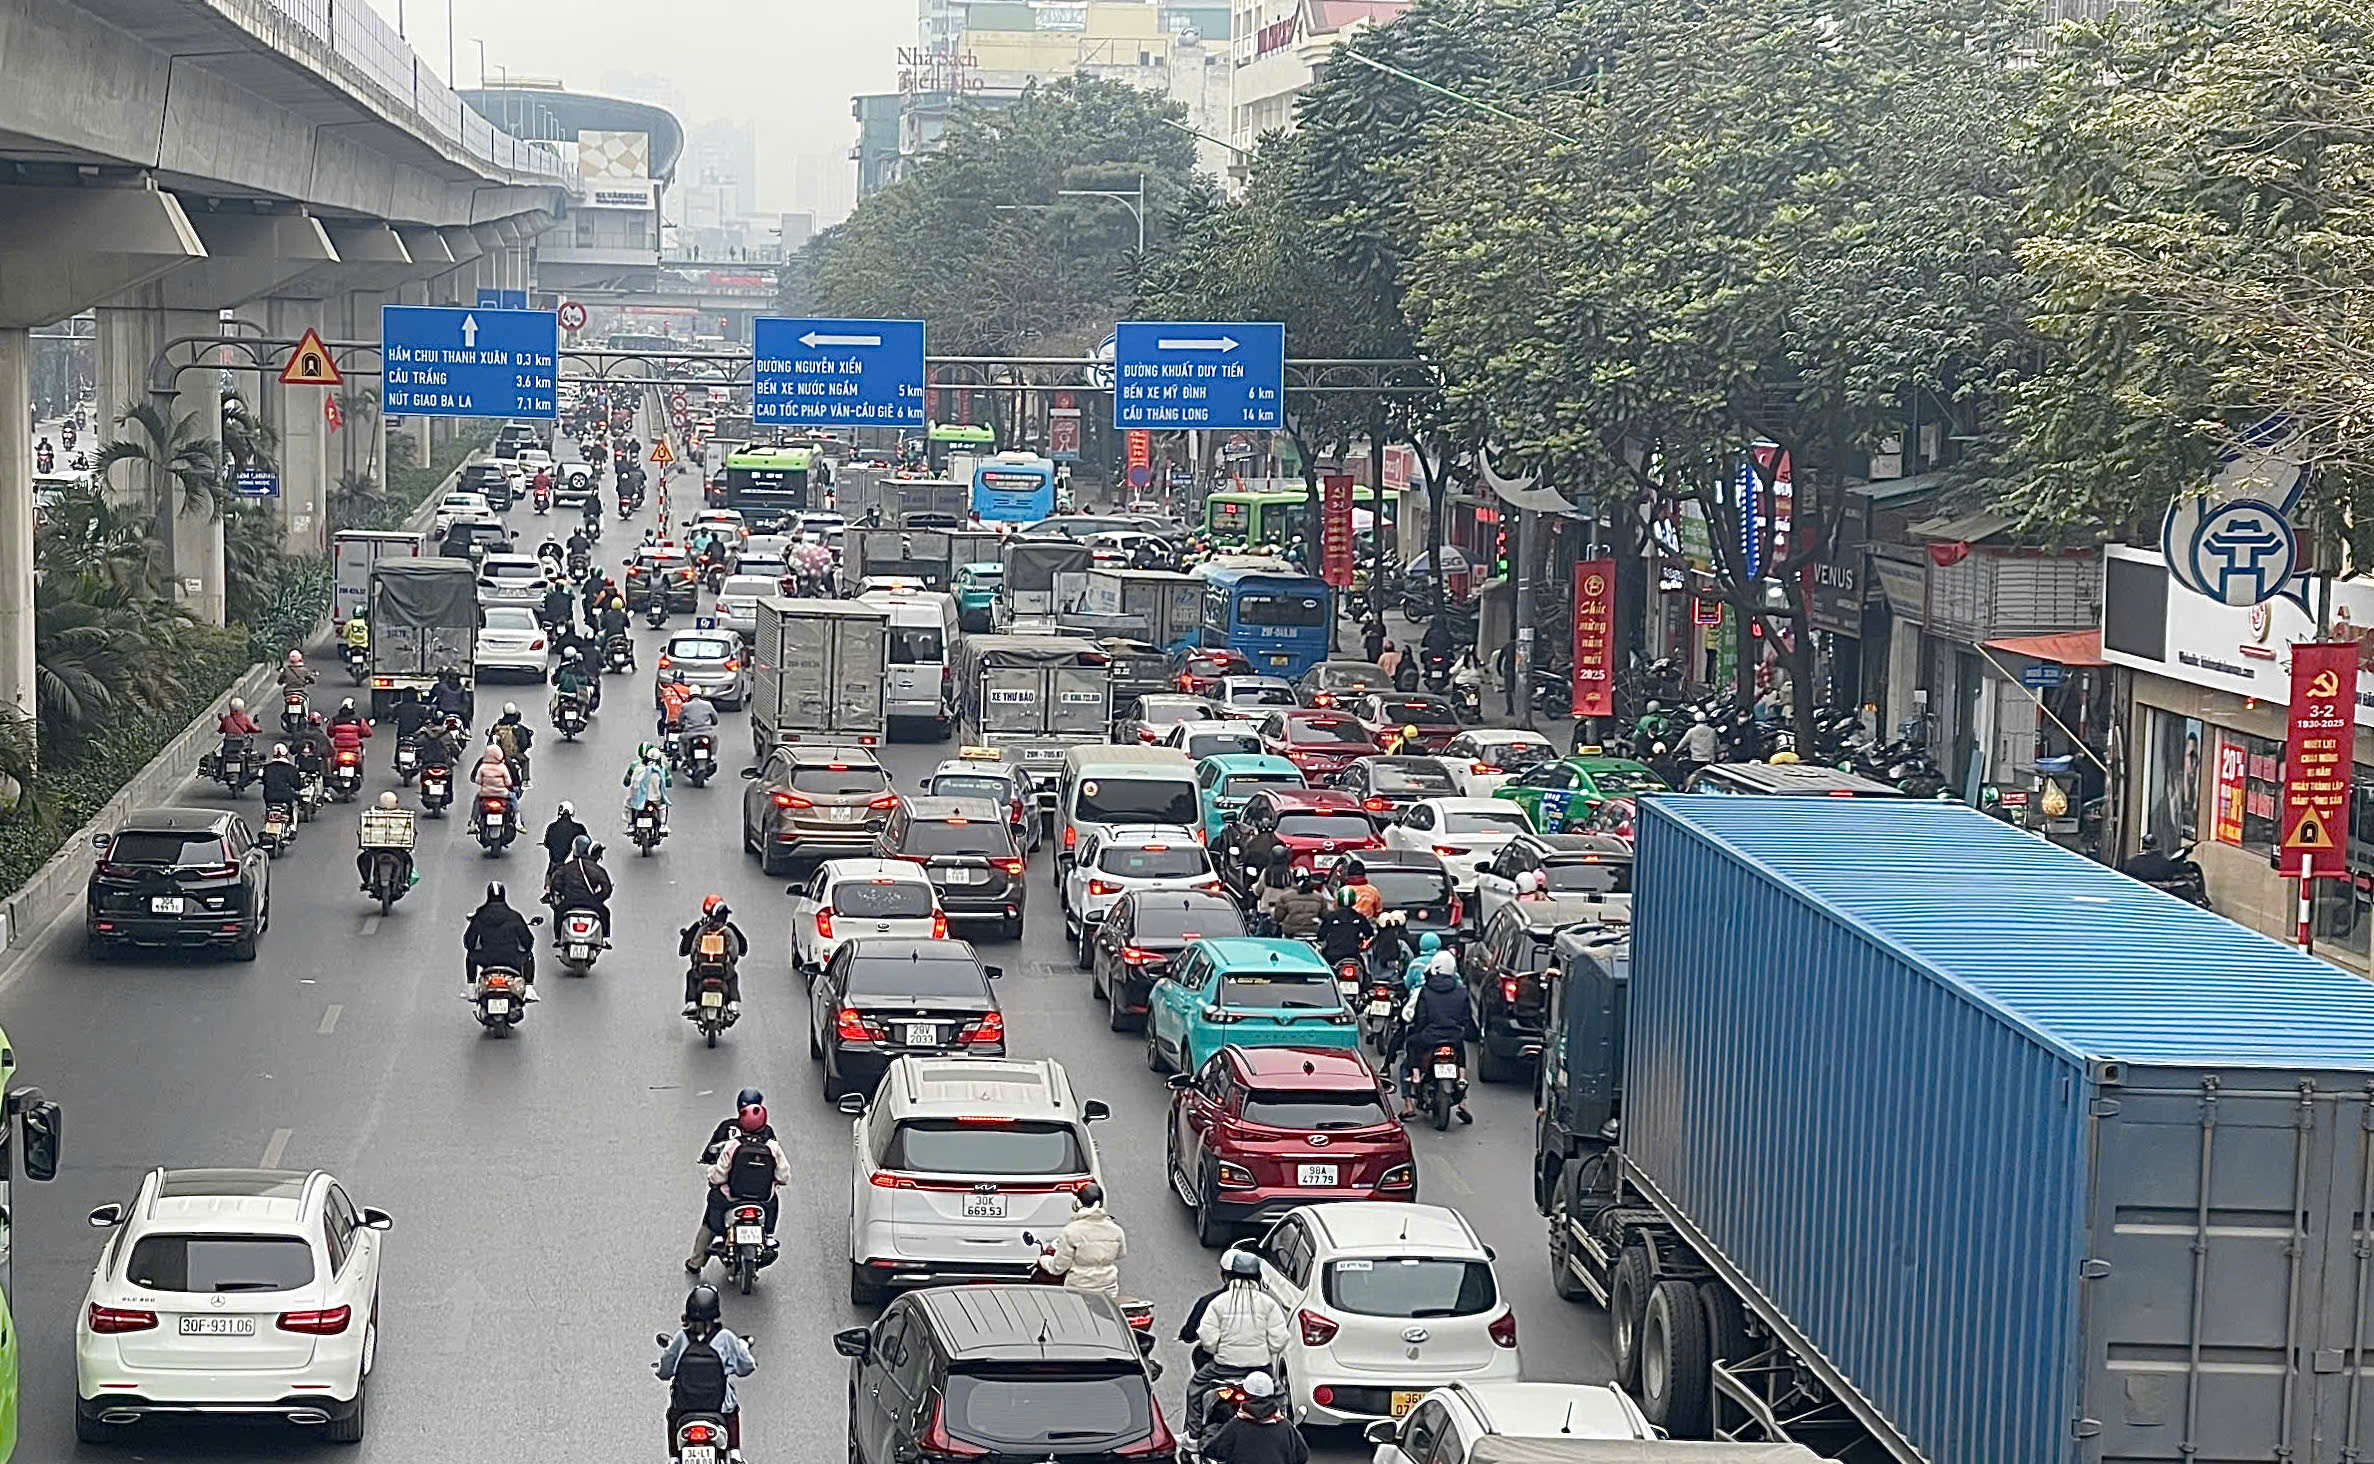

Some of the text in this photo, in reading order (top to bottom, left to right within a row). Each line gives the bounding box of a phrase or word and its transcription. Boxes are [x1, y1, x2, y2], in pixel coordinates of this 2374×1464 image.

[896, 46, 932, 66] Nhà
[414, 350, 438, 363] CHUI
[443, 350, 476, 364] THANH
[536, 354, 552, 366] km
[757, 357, 791, 373] ĐƯỜNG
[1124, 360, 1244, 377] ĐƯỜNG KHUẤT DUY TIẾN
[413, 368, 447, 385] TRẮNG
[516, 376, 531, 388] 3.6
[536, 376, 551, 388] km
[757, 378, 776, 394] BẾN
[781, 383, 793, 395] XE
[798, 380, 824, 396] NƯỚC
[898, 384, 904, 396] 5
[908, 384, 922, 396] km
[1124, 382, 1274, 399] BẾN XE MỸ ĐÌNH 6 km
[389, 390, 410, 406] NÚT
[414, 394, 437, 407] GIAO
[441, 395, 454, 408] BA
[458, 396, 472, 408] LA
[536, 398, 552, 411] km
[756, 404, 776, 416] CAO
[780, 400, 799, 416] TỐC
[801, 402, 826, 417] PHÁP
[878, 402, 894, 418] GIẼ
[898, 406, 904, 418] 6
[908, 406, 922, 418] km
[1182, 408, 1208, 420] LONG
[1243, 408, 1254, 420] 14
[1258, 408, 1274, 420] km
[1814, 562, 1853, 590] VENUS
[1580, 601, 1606, 614] Chúc
[1580, 670, 1606, 680] 2025
[992, 692, 1000, 700] XE
[1004, 692, 1018, 701] THƯ
[2310, 705, 2334, 718] 3-2
[910, 1035, 933, 1044] 2033
[1309, 1166, 1326, 1175] 98A
[1302, 1176, 1334, 1184] 477.79
[976, 1195, 994, 1206] 30K
[968, 1206, 1002, 1216] 669.53
[182, 1318, 252, 1332] 30F-931.06
